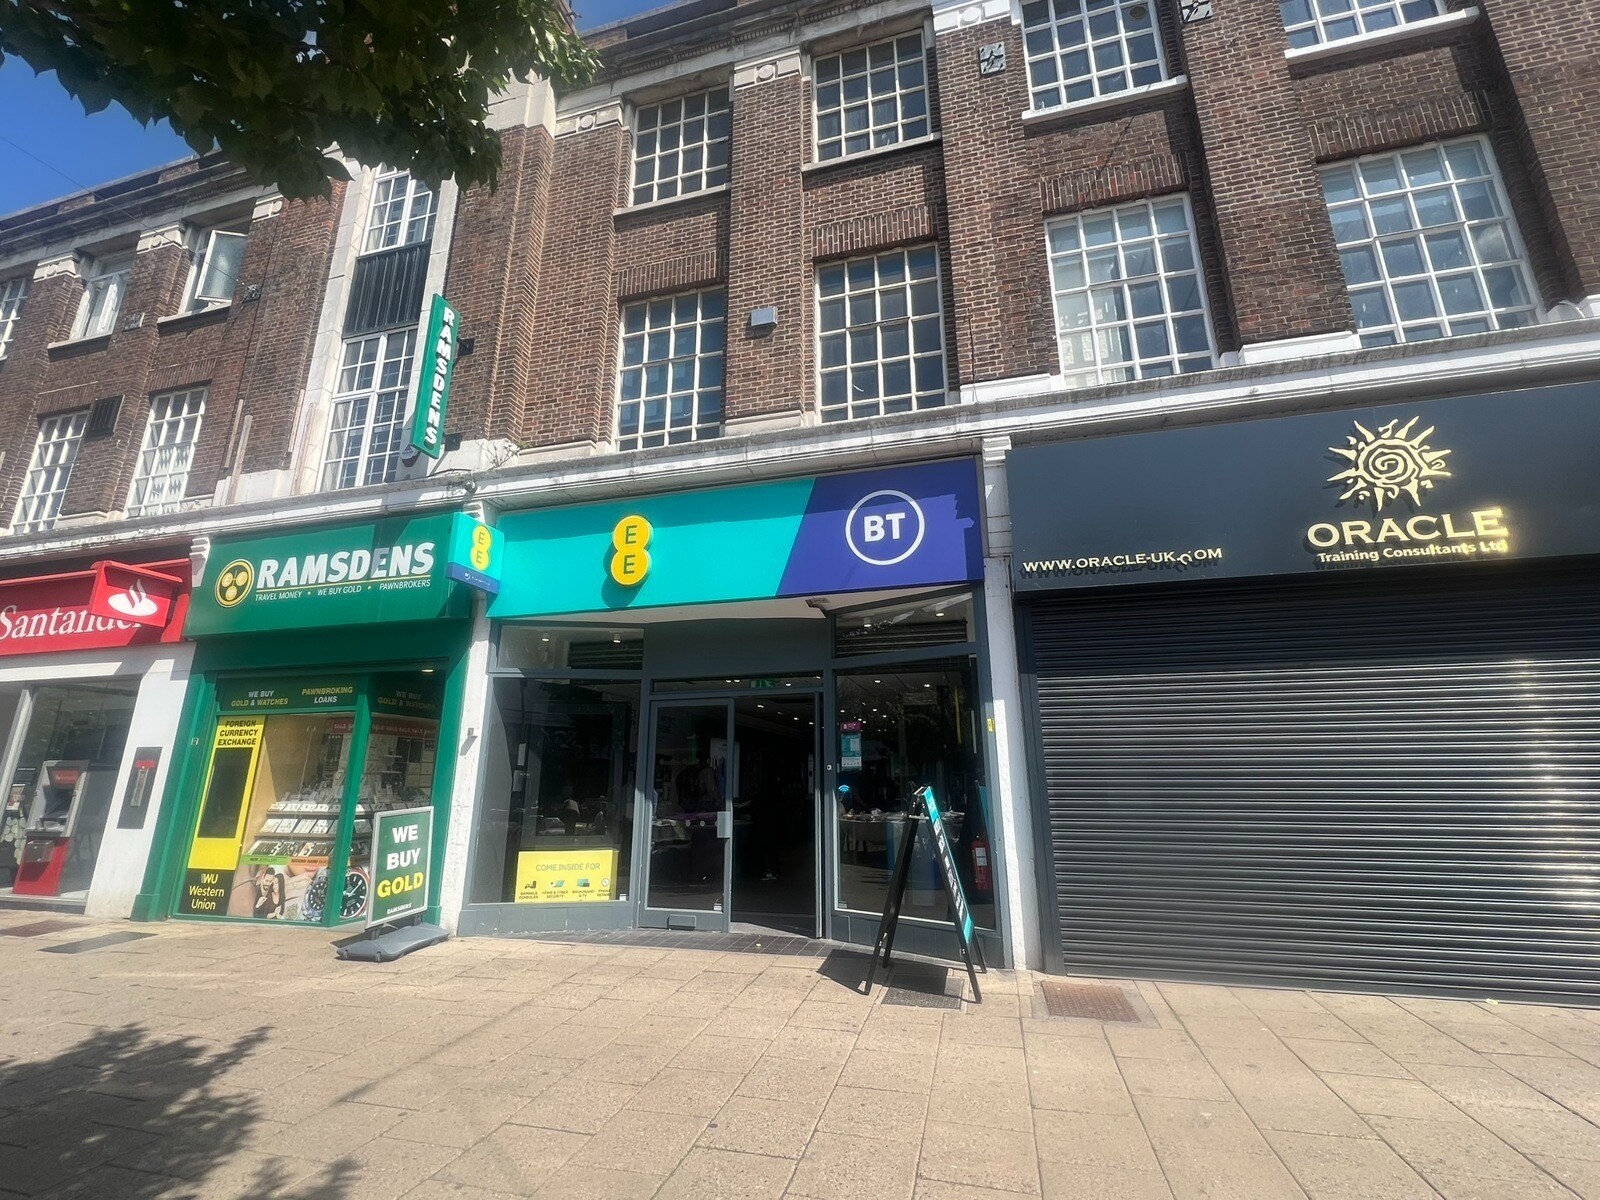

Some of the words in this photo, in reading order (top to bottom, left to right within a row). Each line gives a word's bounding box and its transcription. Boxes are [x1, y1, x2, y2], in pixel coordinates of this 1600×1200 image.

[424, 306, 455, 445] RAMSDENS
[863, 512, 906, 542] BT
[1307, 508, 1509, 547] ORACLE
[475, 531, 485, 564] EE
[623, 524, 637, 575] EE
[1317, 550, 1379, 562] Training
[1383, 542, 1477, 558] Consultants
[1479, 539, 1508, 552] Ltd
[256, 542, 436, 589] RAMSDENS
[255, 593, 278, 602] TRAVEL
[279, 590, 302, 599] MONEY
[317, 588, 327, 596] WE
[328, 586, 342, 595] BUY
[343, 585, 362, 594] GOLD
[379, 579, 431, 591] PAWNBROKERS
[248, 690, 260, 698] WE
[260, 690, 274, 698] BUY
[301, 686, 353, 696] PAWNBROKING
[314, 695, 338, 703] LOANS
[231, 699, 249, 707] GOLD
[256, 697, 288, 706] WATCHES
[219, 728, 259, 737] CURRENCY
[224, 720, 256, 728] FOREIGN
[217, 738, 257, 746] EXCHANGE
[392, 824, 418, 844] WE
[386, 848, 421, 870] BUY
[535, 864, 557, 872] COME
[558, 863, 584, 871] INSIDE
[189, 885, 225, 897] Western
[377, 872, 424, 898] GOLD
[191, 898, 216, 910] Union
